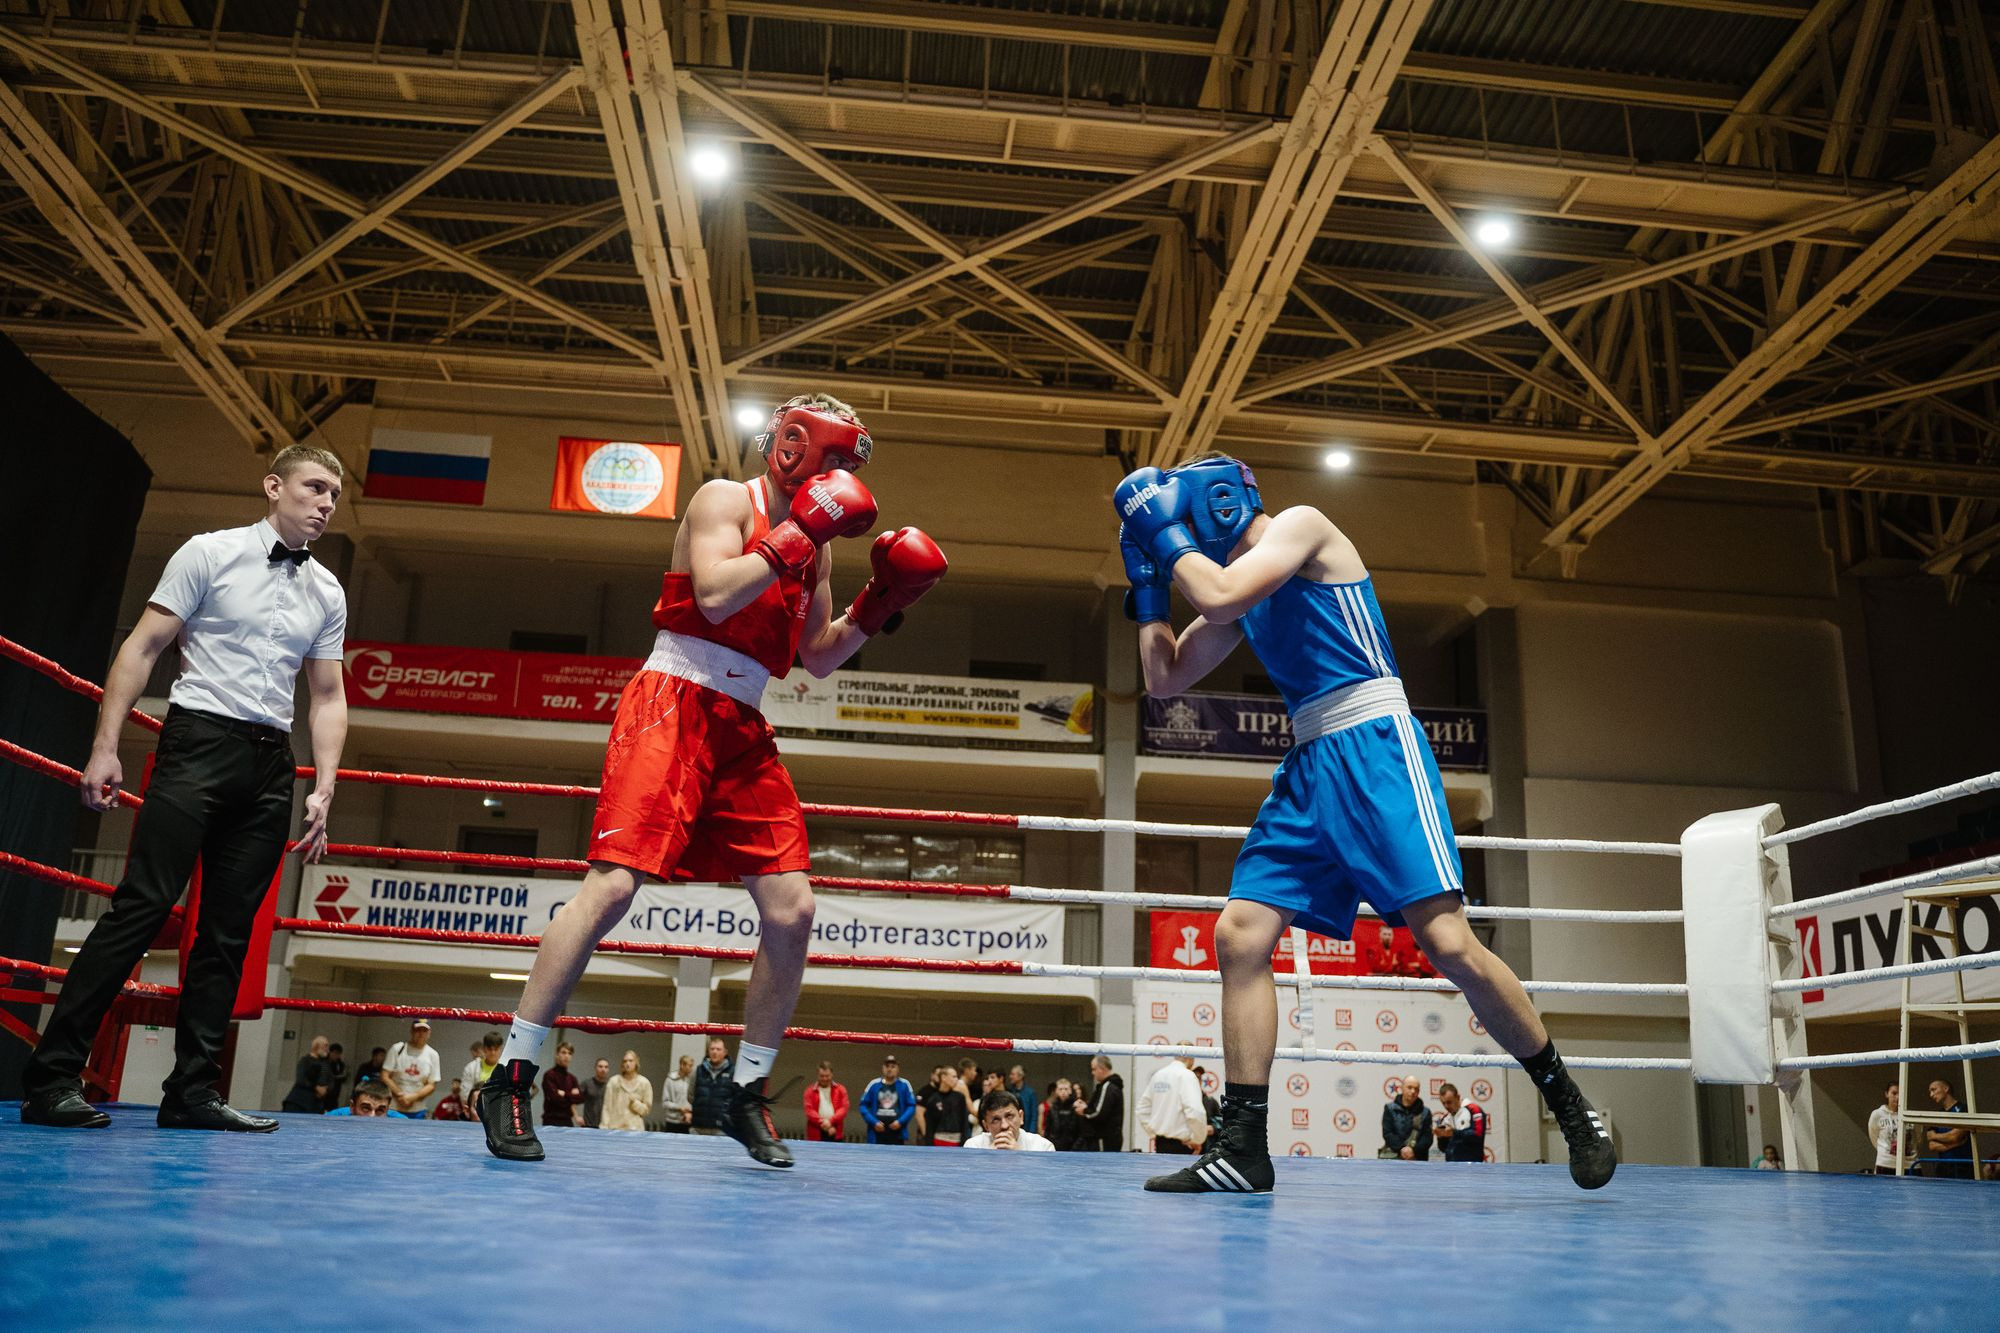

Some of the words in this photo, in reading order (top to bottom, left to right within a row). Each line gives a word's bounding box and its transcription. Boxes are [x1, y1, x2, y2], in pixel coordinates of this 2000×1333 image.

[807, 484, 845, 521] clinch
[1123, 482, 1162, 517] clinch
[367, 664, 495, 689] СВЯЗИСТ
[542, 694, 583, 709] тел.
[837, 693, 844, 702] И
[977, 700, 1020, 713] РАБОТЫ
[371, 878, 528, 908] ГЛОБАЛСТРОЙ
[367, 905, 528, 935] ИНЖИНИРИНГ
[630, 906, 1047, 955] «ГСИ-Вонефтегазстрой»
